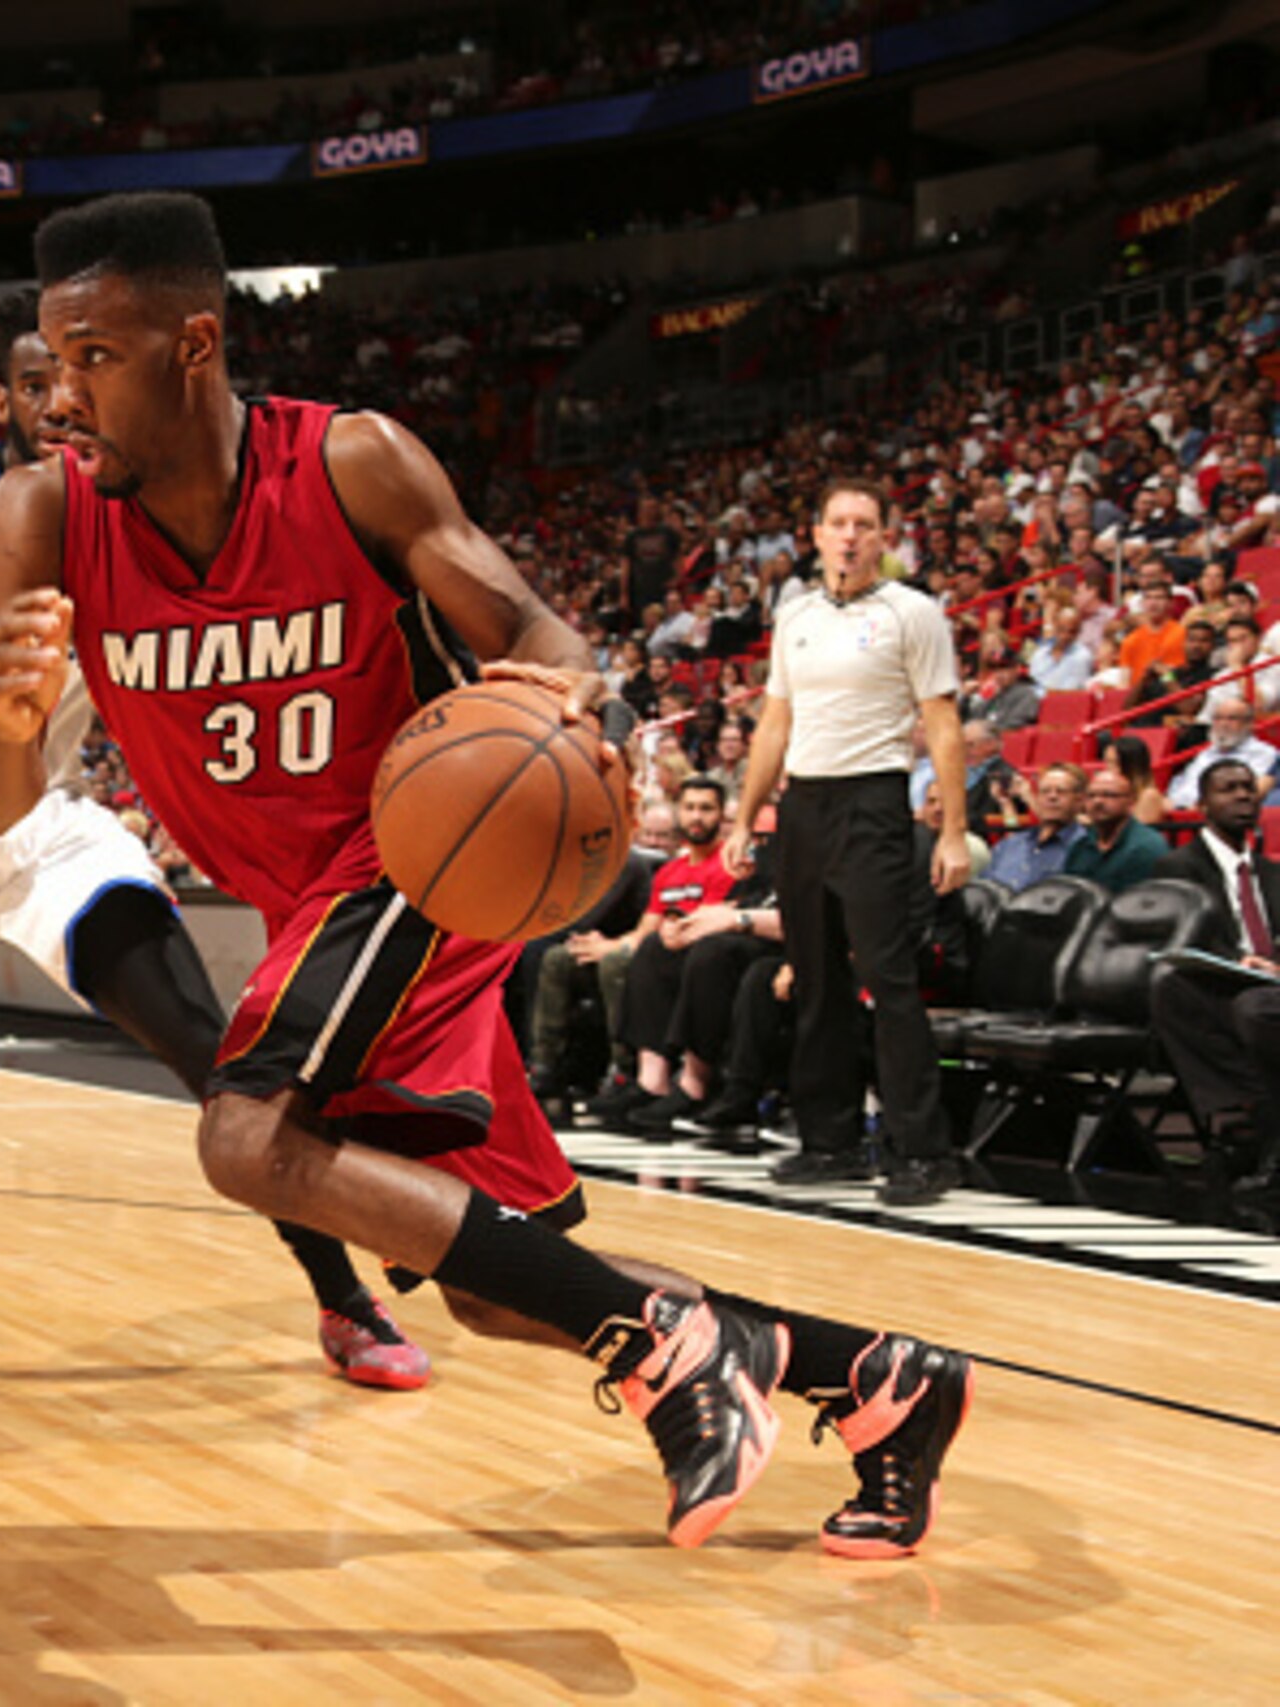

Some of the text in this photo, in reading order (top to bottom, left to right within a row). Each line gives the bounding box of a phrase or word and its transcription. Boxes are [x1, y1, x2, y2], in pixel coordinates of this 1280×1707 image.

[761, 40, 859, 91] GOYA
[321, 127, 419, 168] GOYA
[101, 600, 345, 692] MIAMI
[204, 689, 335, 783] 30
